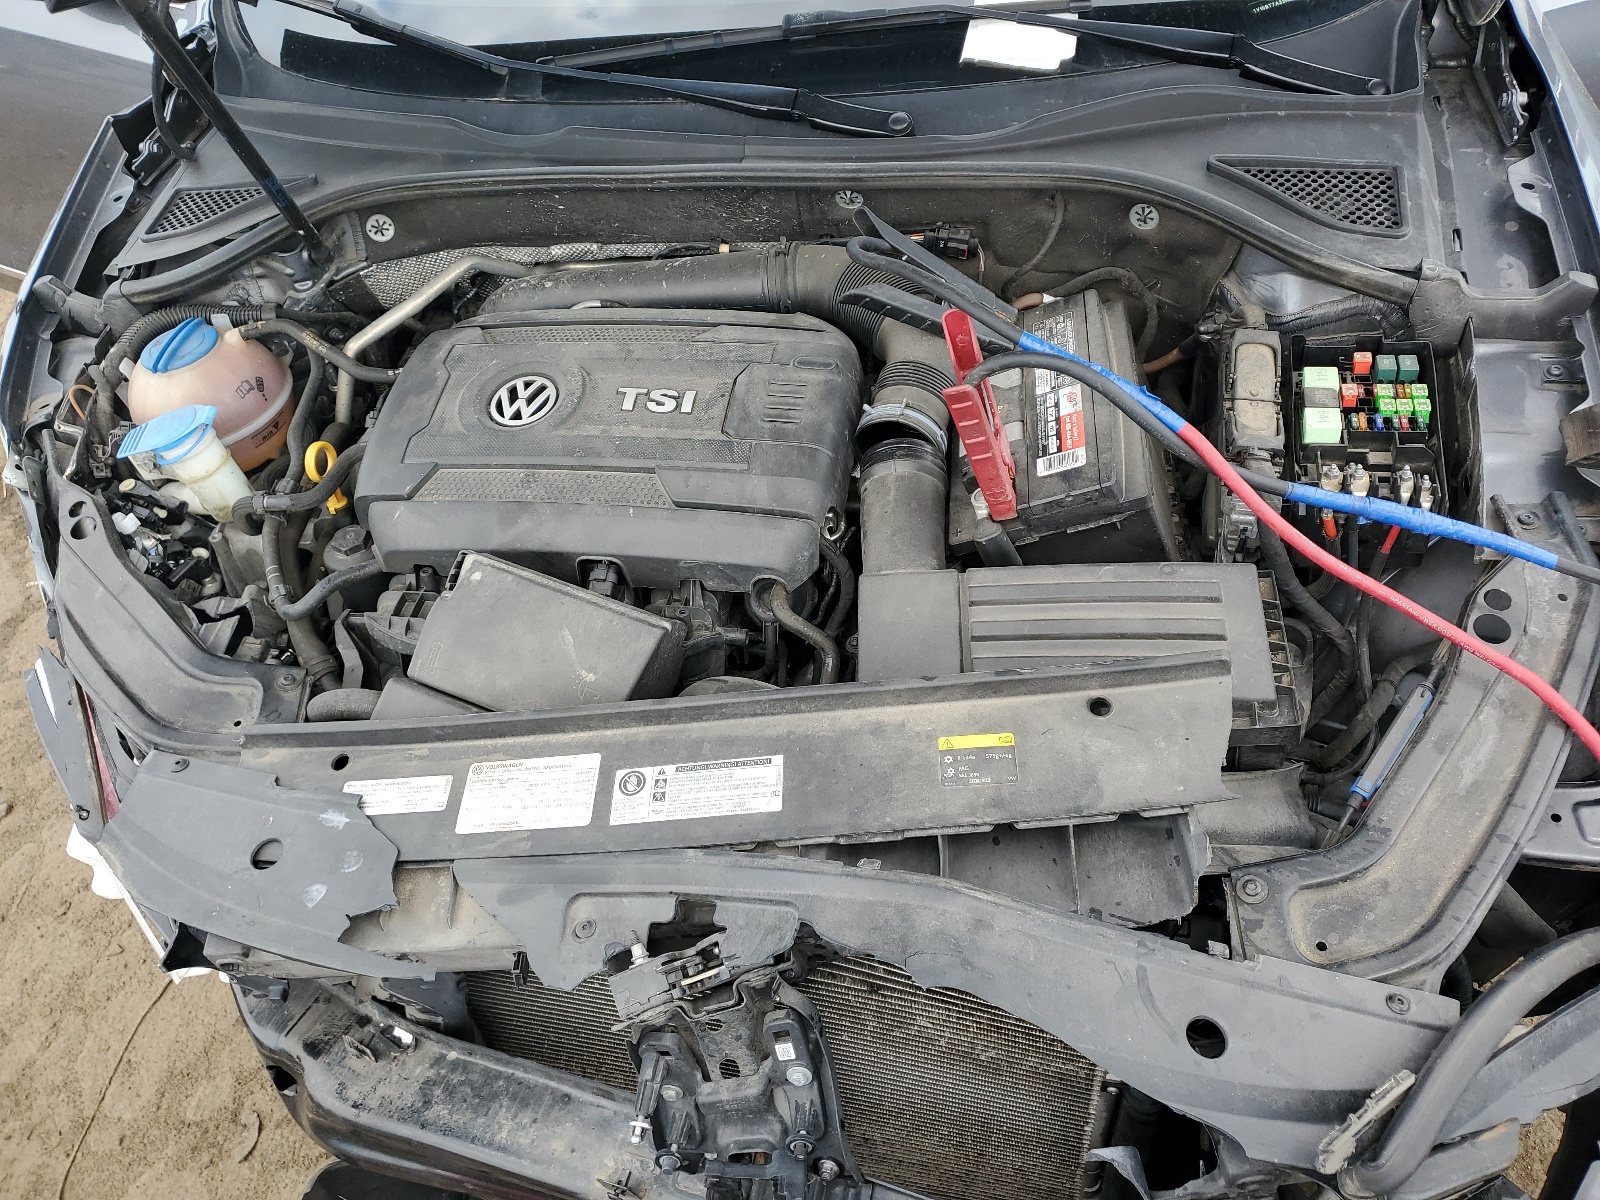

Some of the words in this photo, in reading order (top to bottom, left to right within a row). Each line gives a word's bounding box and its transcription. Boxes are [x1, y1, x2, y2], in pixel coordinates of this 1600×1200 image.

[618, 387, 697, 414] TSI
[261, 430, 274, 442] min
[485, 762, 524, 770] VOLKSWAGEN
